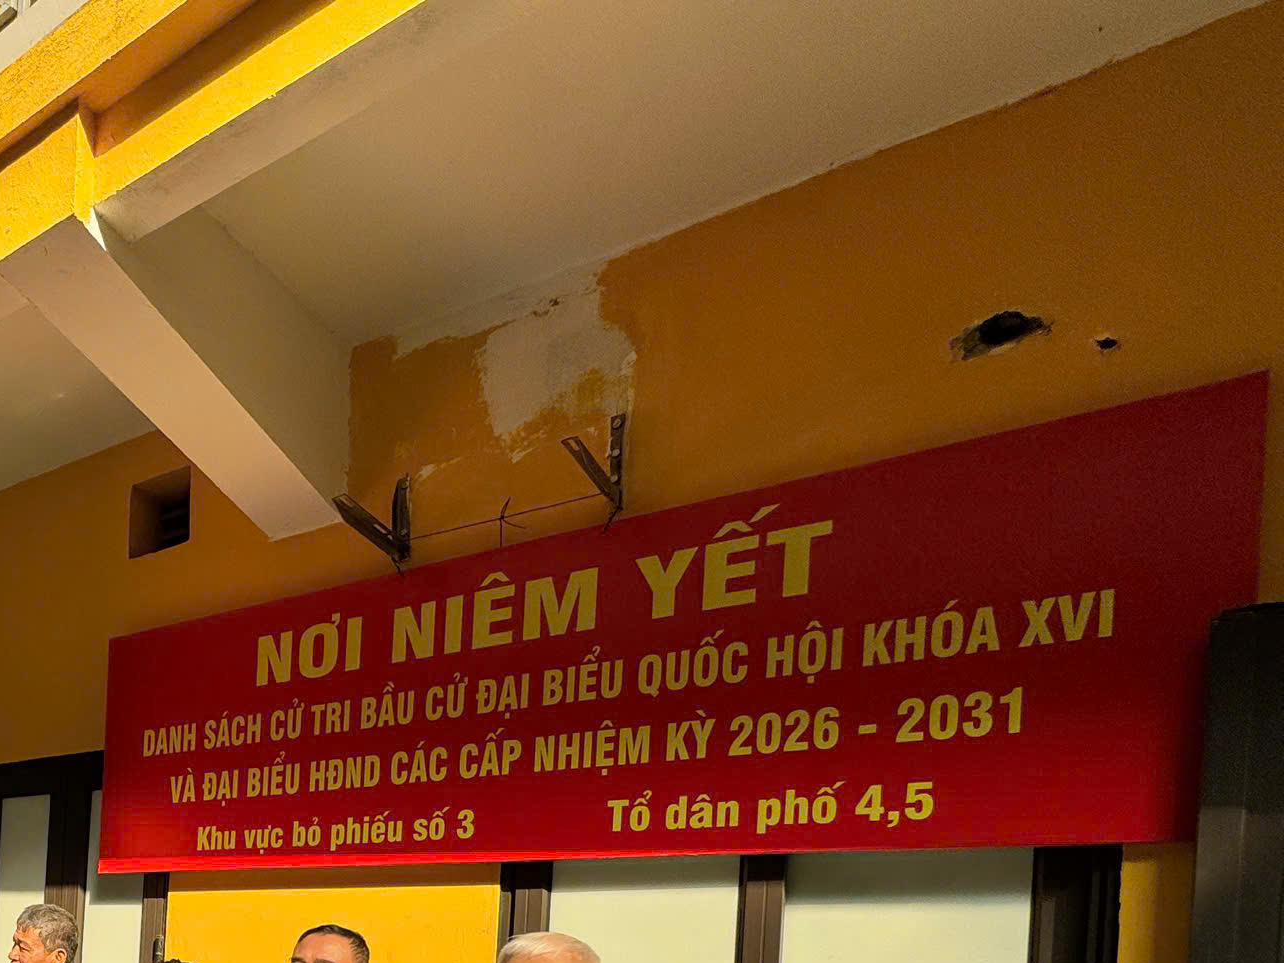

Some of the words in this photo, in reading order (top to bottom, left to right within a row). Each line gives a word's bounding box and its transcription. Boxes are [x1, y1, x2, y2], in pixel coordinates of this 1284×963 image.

[256, 613, 362, 687] NƠI
[391, 568, 599, 663] NIÊM
[635, 504, 833, 619] YẾT
[143, 723, 197, 757] DANH
[203, 711, 262, 750] SÁCH
[270, 697, 304, 741] CỬ
[311, 700, 351, 735] TRI
[360, 682, 415, 729] BẦU
[425, 664, 470, 721] CỬ
[475, 673, 530, 719] ĐẠI
[542, 646, 623, 706] BIỂU
[637, 630, 749, 698] QUỐC
[766, 620, 843, 684] HỘI
[862, 599, 1000, 667] KHÓA
[1019, 589, 1116, 648] XVI
[170, 768, 196, 804] VÀ
[202, 768, 239, 807] ĐẠI
[246, 751, 300, 798] BIỂU
[309, 755, 381, 793] HĐND
[390, 741, 448, 785] CÁC
[459, 728, 522, 779] CẤP
[533, 720, 651, 776] NHIỆM
[665, 710, 716, 762] KỲ
[728, 706, 840, 757] 2026
[858, 723, 877, 735] -
[895, 687, 1025, 743] 2031
[196, 825, 237, 851] Khu
[243, 826, 284, 855] vực
[292, 817, 322, 847] bỏ
[330, 810, 403, 852] phiếu
[412, 806, 450, 842] số
[456, 809, 476, 839] 3
[607, 790, 652, 832] Tổ
[665, 794, 740, 830] dân
[756, 781, 845, 835] phố
[854, 781, 935, 829] 4,5
